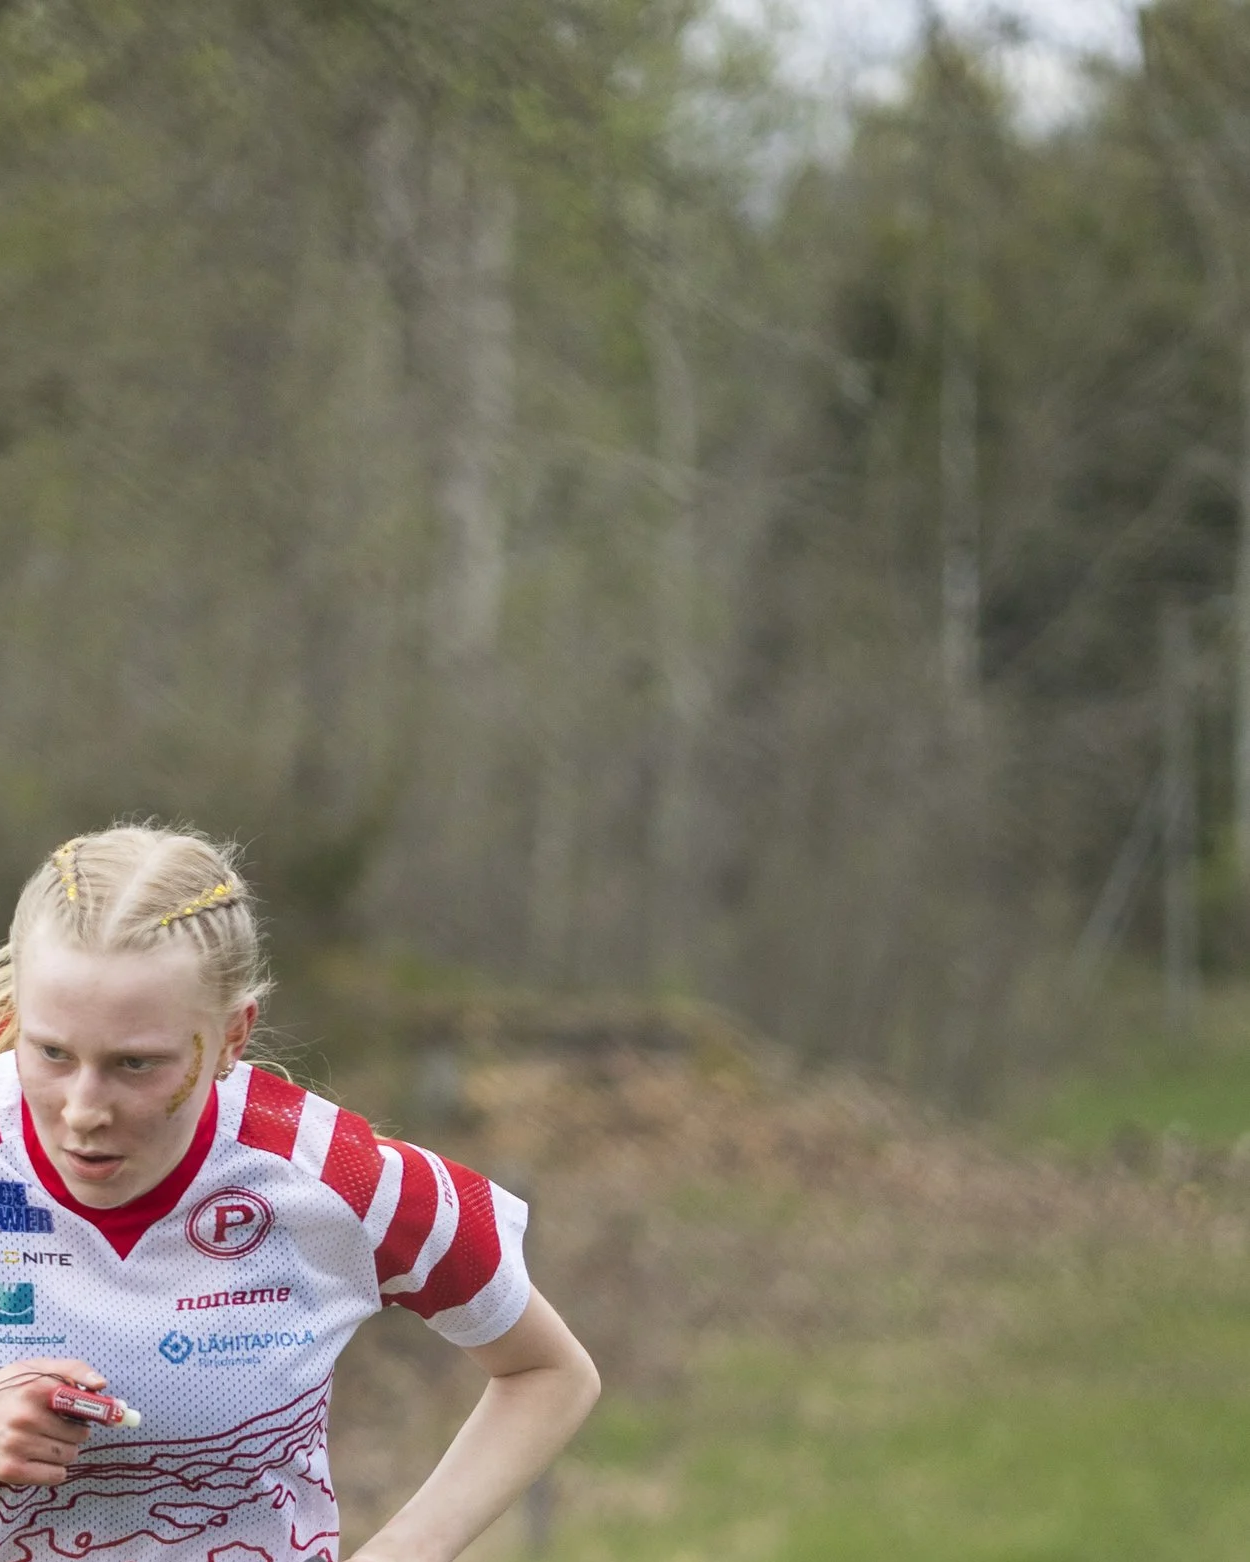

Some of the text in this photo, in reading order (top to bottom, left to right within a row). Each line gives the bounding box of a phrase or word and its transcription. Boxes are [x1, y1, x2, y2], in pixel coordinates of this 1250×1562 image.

[212, 1204, 256, 1243] P
[176, 1286, 291, 1312] noname
[198, 1330, 315, 1353] LÄHITAPIOLA
